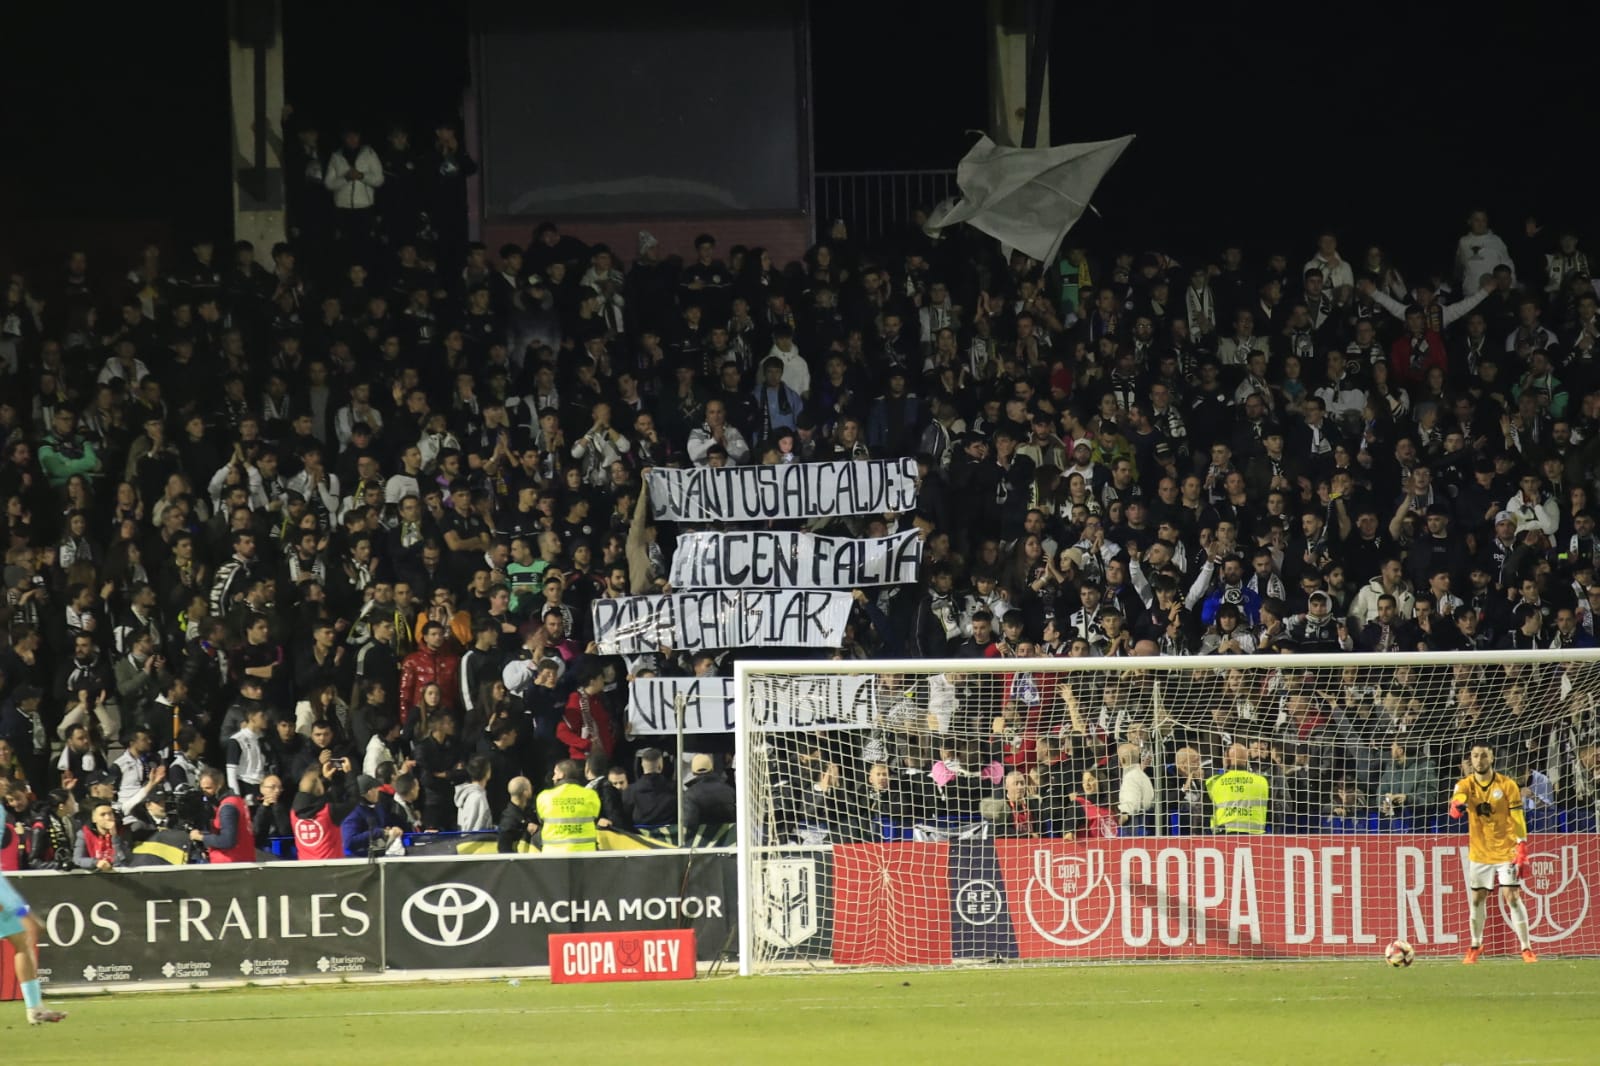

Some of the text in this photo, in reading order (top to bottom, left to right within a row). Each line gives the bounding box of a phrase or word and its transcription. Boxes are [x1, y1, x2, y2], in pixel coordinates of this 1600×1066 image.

[783, 457, 918, 517] ALCALDES
[675, 531, 921, 587] HACEN FALTA
[594, 588, 834, 653] PARA CAMBIAR
[1531, 861, 1554, 876] COPA
[510, 895, 723, 925] HACHA MOTOR
[1120, 846, 1263, 947] COPA
[1284, 846, 1377, 944] DEL
[36, 892, 371, 948] OS FRAILES
[176, 960, 212, 970] turismo
[254, 958, 290, 967] turismo
[331, 955, 366, 964] turismo
[563, 941, 617, 976] COPA
[643, 939, 681, 973] REY
